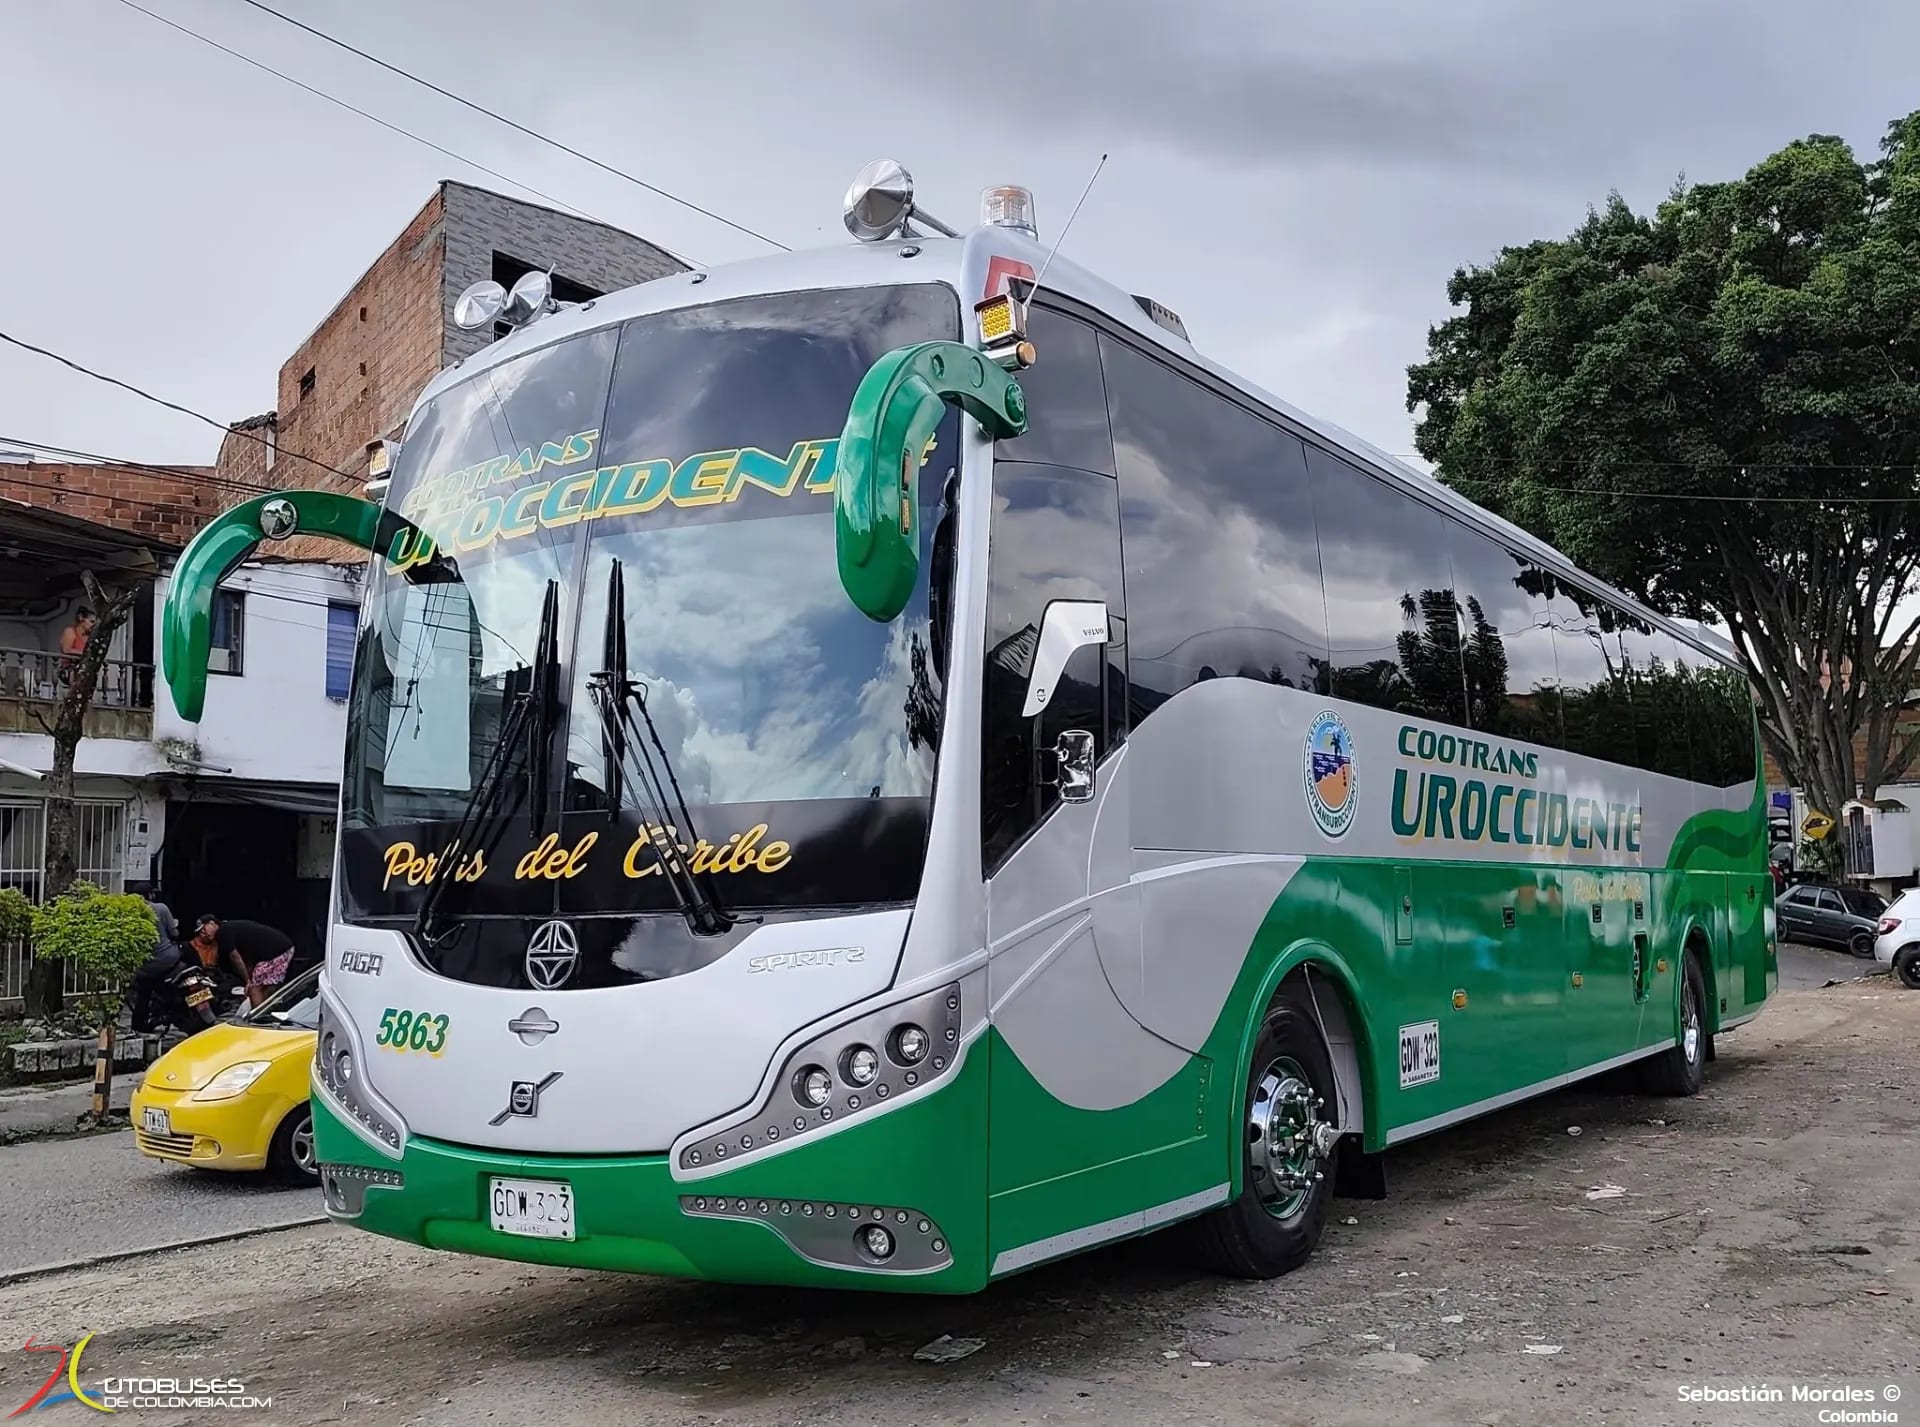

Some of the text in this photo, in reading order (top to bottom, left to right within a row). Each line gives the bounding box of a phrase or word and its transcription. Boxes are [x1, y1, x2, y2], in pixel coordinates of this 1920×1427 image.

[400, 428, 599, 516] COOTRANS
[384, 432, 938, 576] UROCCIDENT
[1397, 725, 1539, 779] COOTRANS
[1390, 767, 1643, 854] UROCCIDENTE
[515, 832, 599, 880] del
[747, 948, 843, 974] SPIRIT
[376, 1007, 450, 1054] 5863
